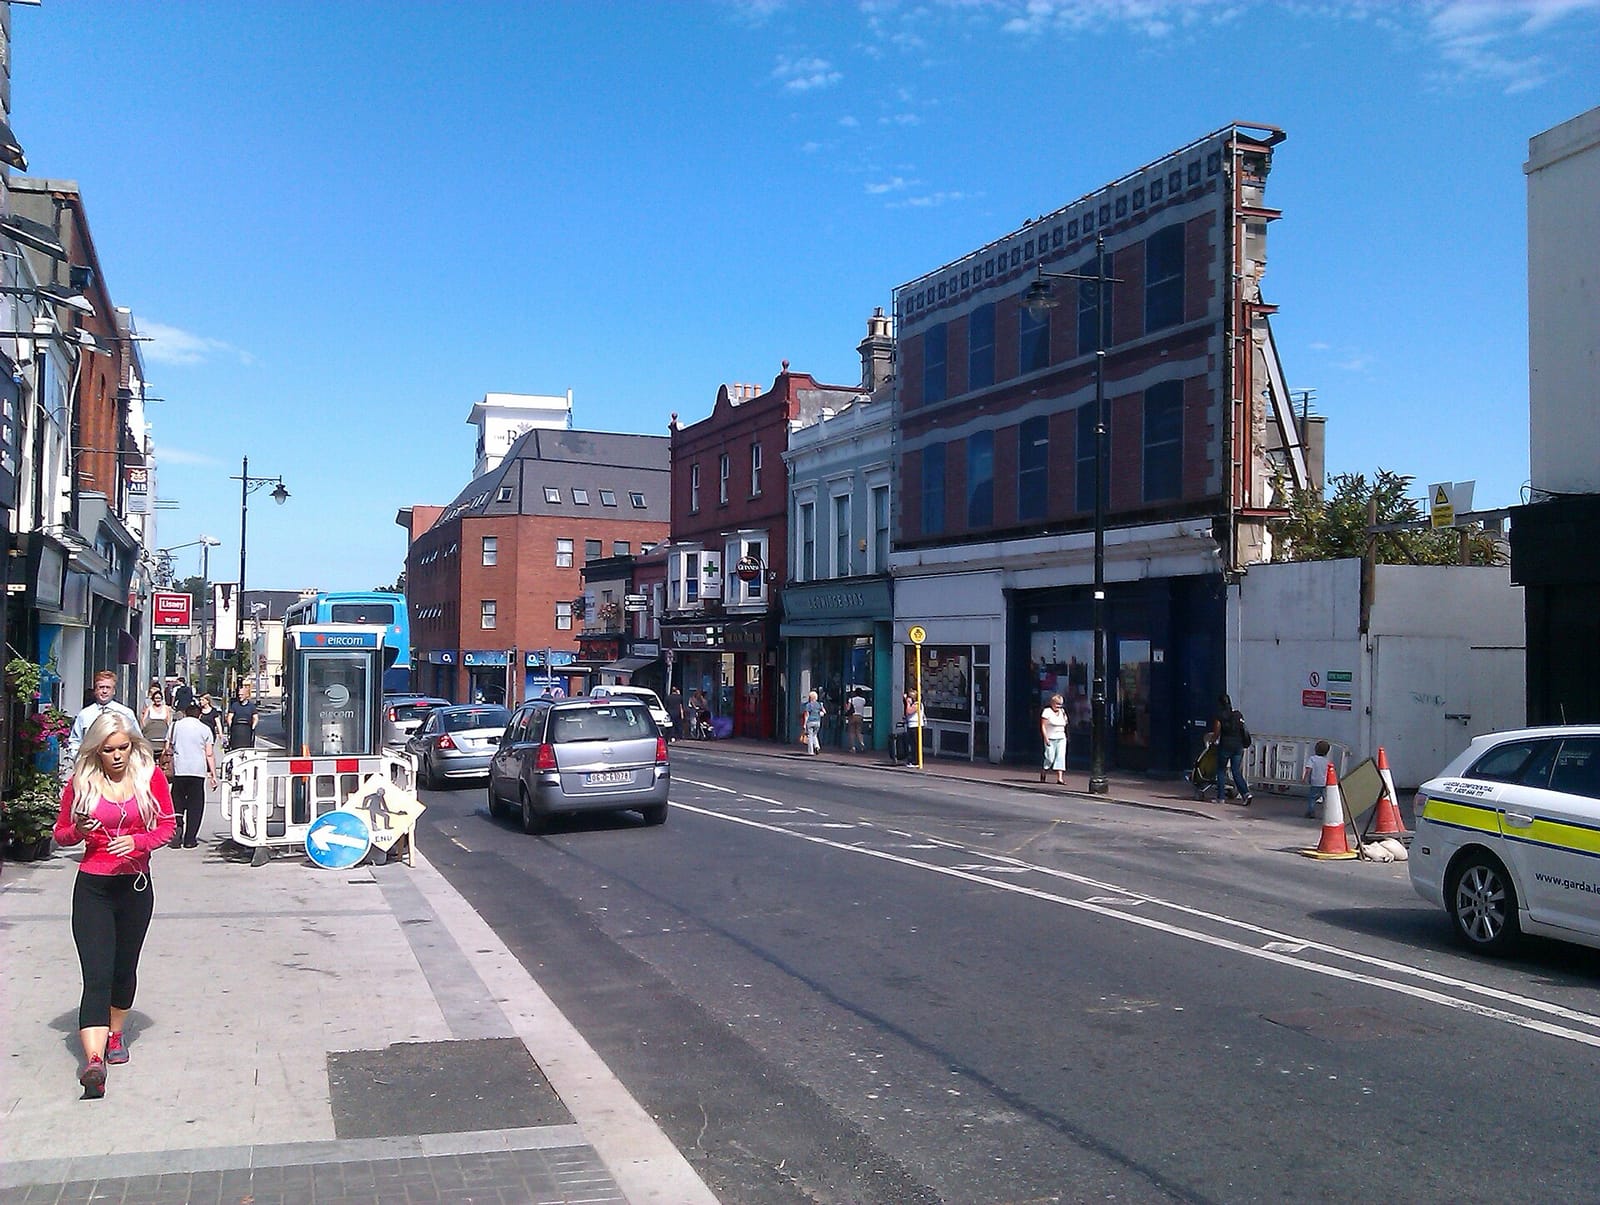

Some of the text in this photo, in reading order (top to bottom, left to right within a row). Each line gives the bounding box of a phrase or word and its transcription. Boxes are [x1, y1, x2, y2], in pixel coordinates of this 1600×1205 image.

[130, 483, 148, 491] AIB
[162, 600, 184, 609] Lisney
[1535, 872, 1600, 895] www.garda.ie
